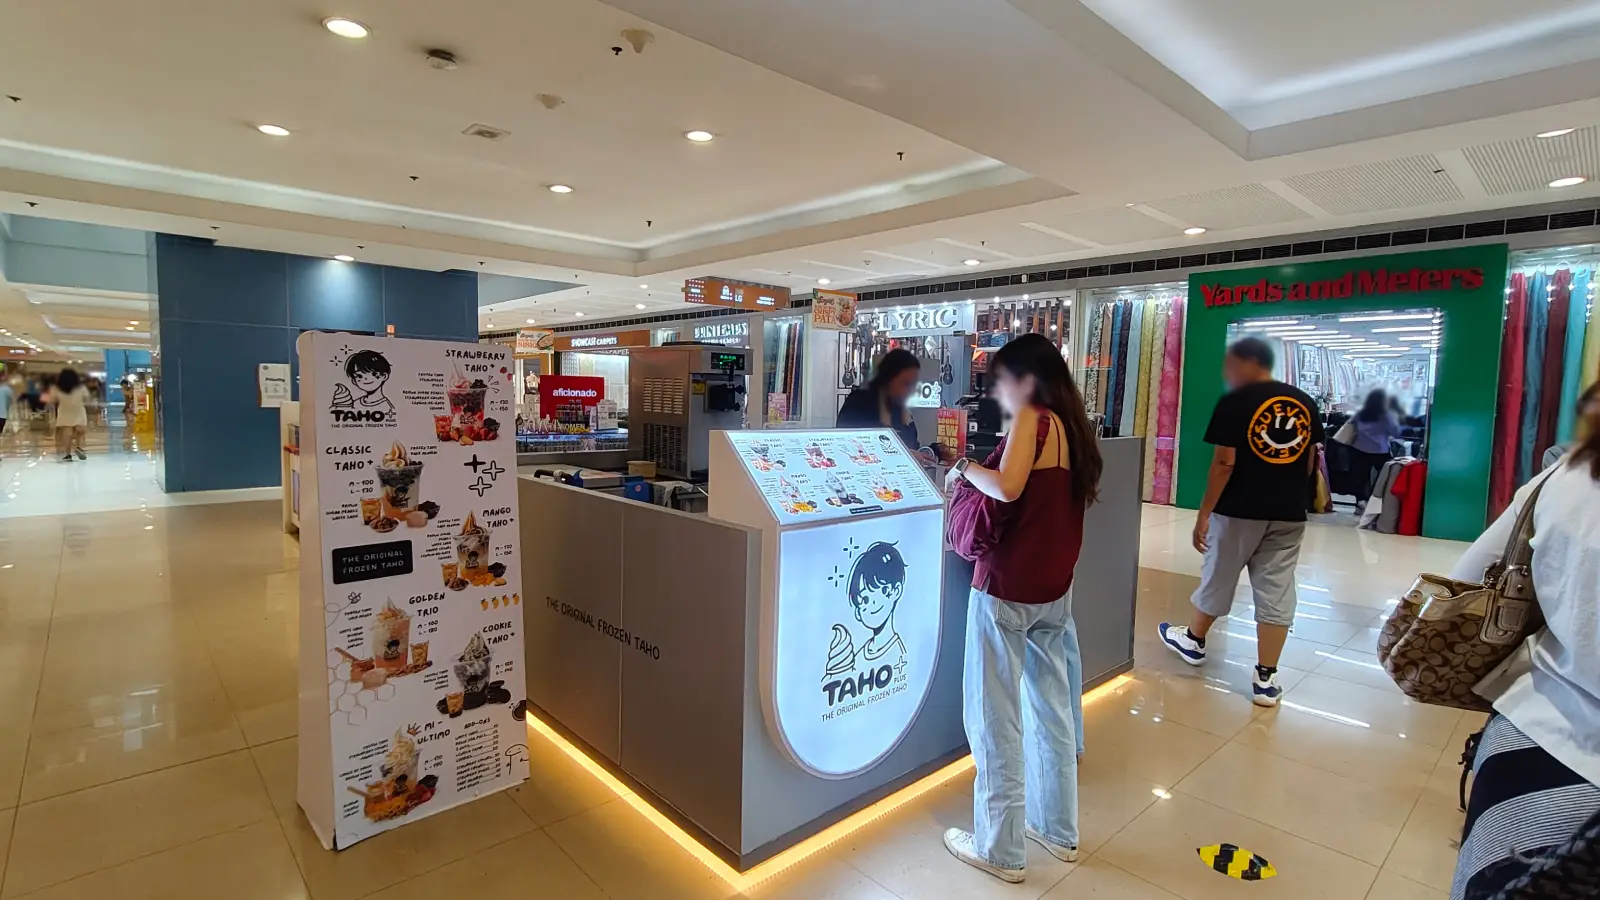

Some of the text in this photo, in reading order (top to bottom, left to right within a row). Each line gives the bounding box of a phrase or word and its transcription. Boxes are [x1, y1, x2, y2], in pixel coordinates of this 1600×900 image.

[1200, 267, 1485, 308] Yards and Meters
[877, 308, 957, 331] LYRIC
[571, 336, 617, 347] SHOWCASE CARPETS
[446, 349, 506, 361] STRAWBERRY
[552, 387, 597, 397] aficionado
[325, 445, 372, 455] CLASSIC
[482, 506, 511, 517] MANGO
[342, 550, 403, 563] THE ORIGINAL
[343, 560, 404, 574] FROZEN TAHO
[408, 591, 445, 604] GOLDEN
[417, 606, 439, 617] TRIO
[483, 621, 512, 633] COOKIE
[546, 596, 660, 660] THE ORIGINAL FROZEN TAHO
[893, 673, 907, 684] PLUS
[822, 684, 908, 722] THE ORIGINAL FROZEN TAHO
[464, 717, 491, 730] ADD-ONS
[417, 729, 451, 744] ULTIMO
